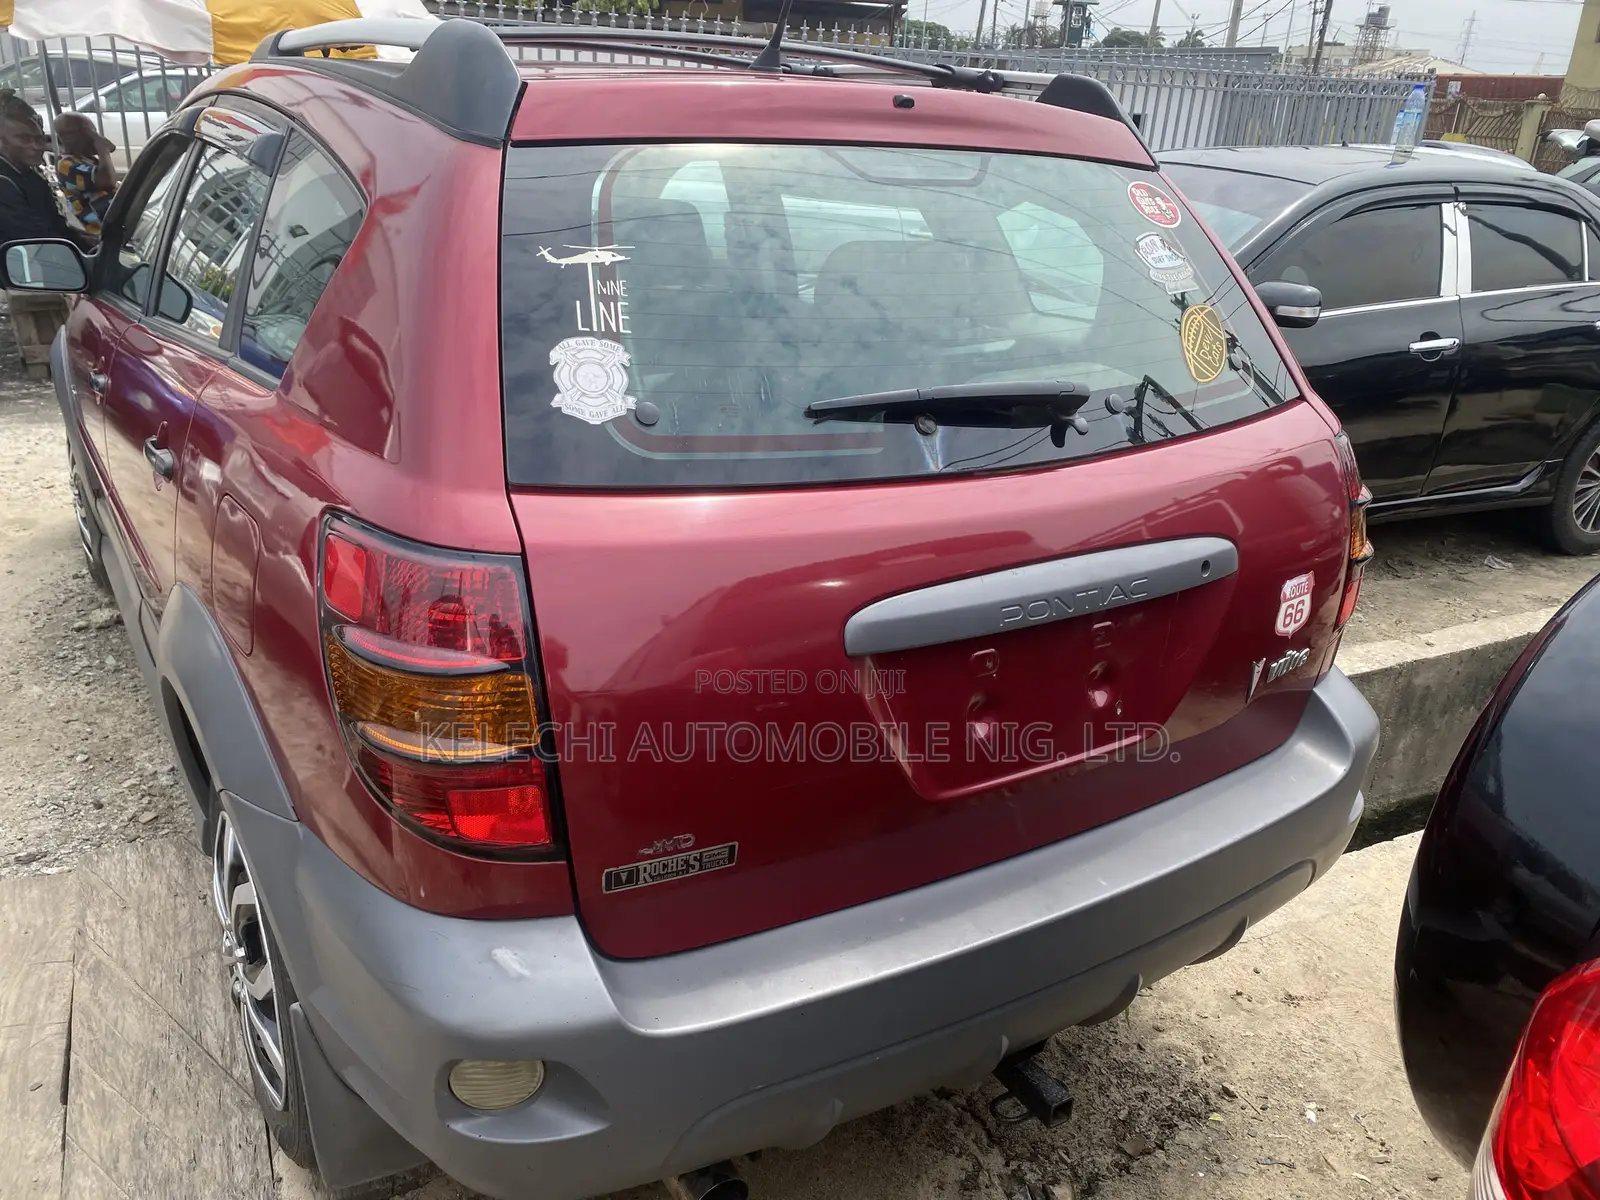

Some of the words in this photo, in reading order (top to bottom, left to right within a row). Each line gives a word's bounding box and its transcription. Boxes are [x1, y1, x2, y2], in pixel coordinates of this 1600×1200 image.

[1131, 188, 1149, 197] OLD
[597, 280, 628, 297] NINE
[576, 300, 632, 334] LINE
[559, 342, 572, 351] ALL
[575, 339, 596, 347] GAVE
[600, 341, 620, 352] SOME
[1200, 328, 1214, 361] Devil
[1210, 342, 1223, 367] Cats
[564, 403, 586, 417] SOME
[589, 410, 609, 419] GAVE
[612, 404, 625, 414] ALL
[1000, 577, 1148, 627] PONTIAC
[1283, 599, 1305, 628] 66
[702, 858, 729, 870] TRUCKS
[704, 851, 727, 859] GMC
[637, 852, 701, 885] ROCHE'S
